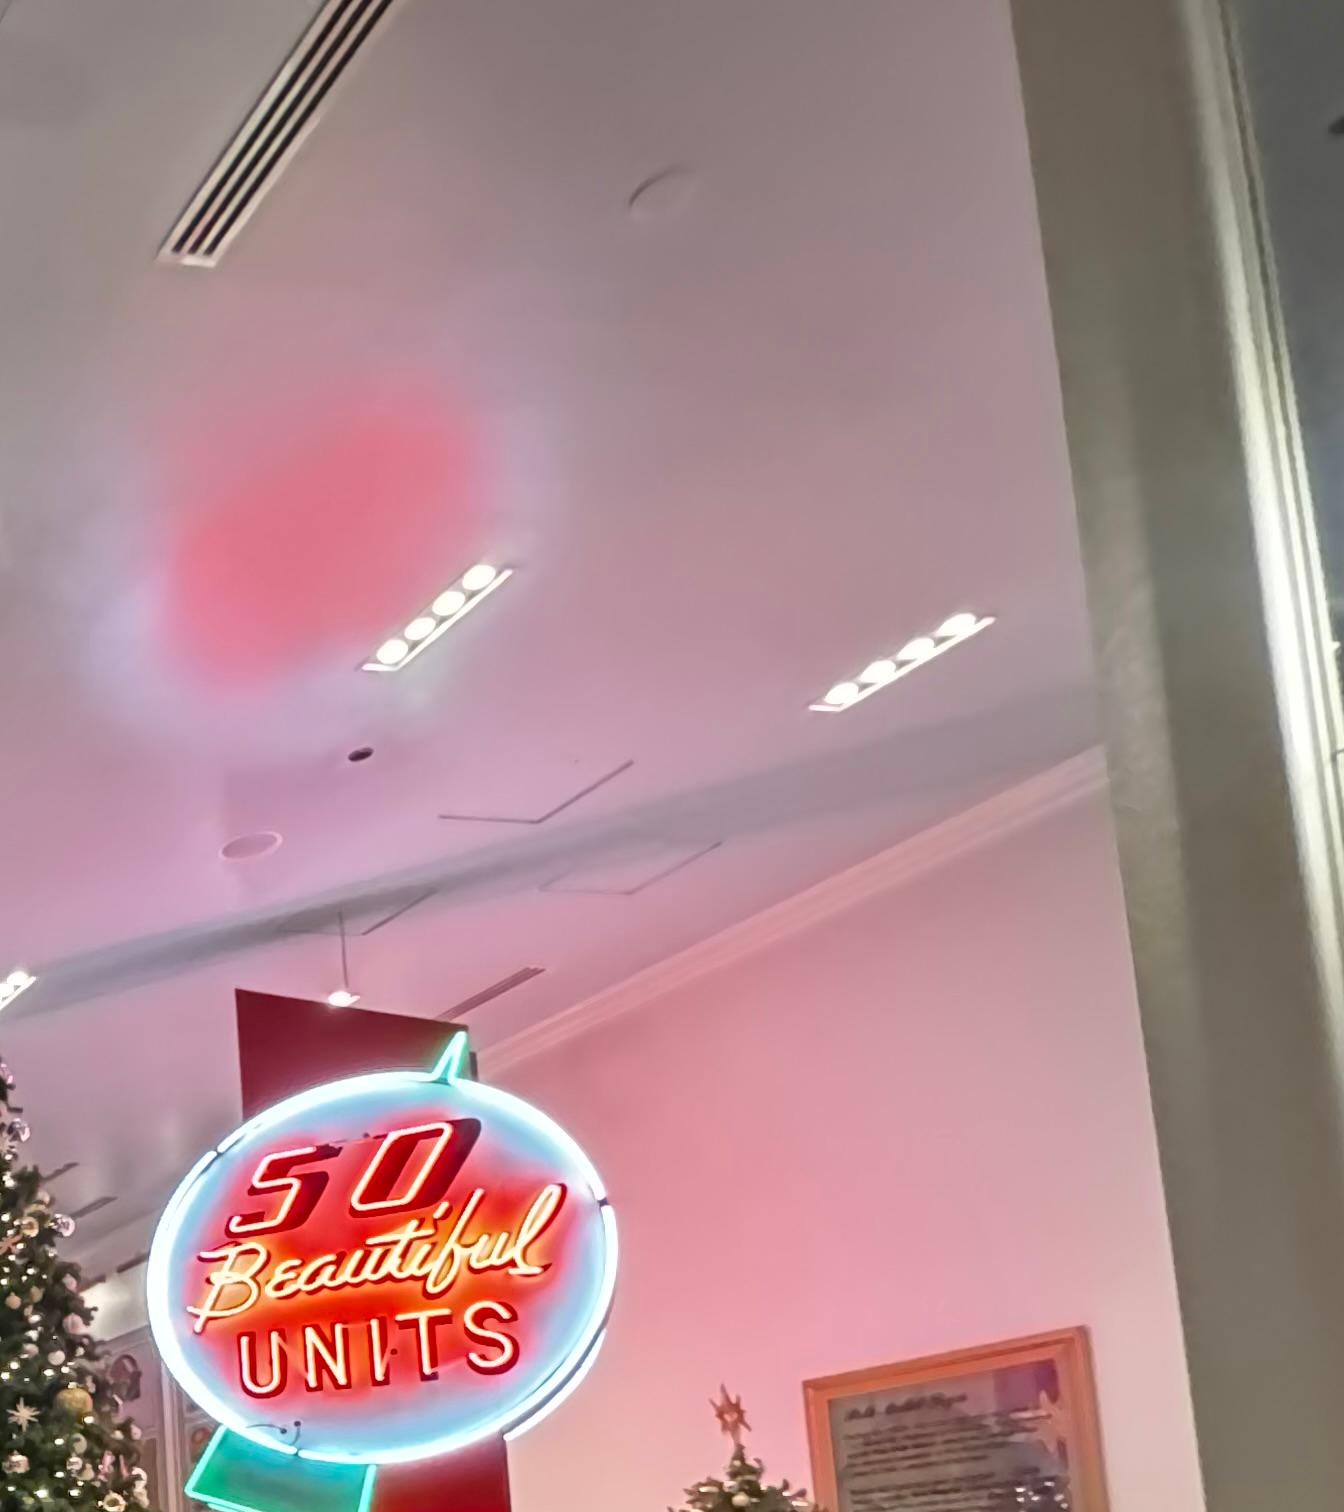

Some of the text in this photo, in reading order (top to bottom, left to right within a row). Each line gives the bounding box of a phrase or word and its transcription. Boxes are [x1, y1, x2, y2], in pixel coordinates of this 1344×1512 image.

[225, 1117, 482, 1238] 50
[187, 1181, 567, 1335] Beautiful
[237, 1301, 520, 1399] UNITS
